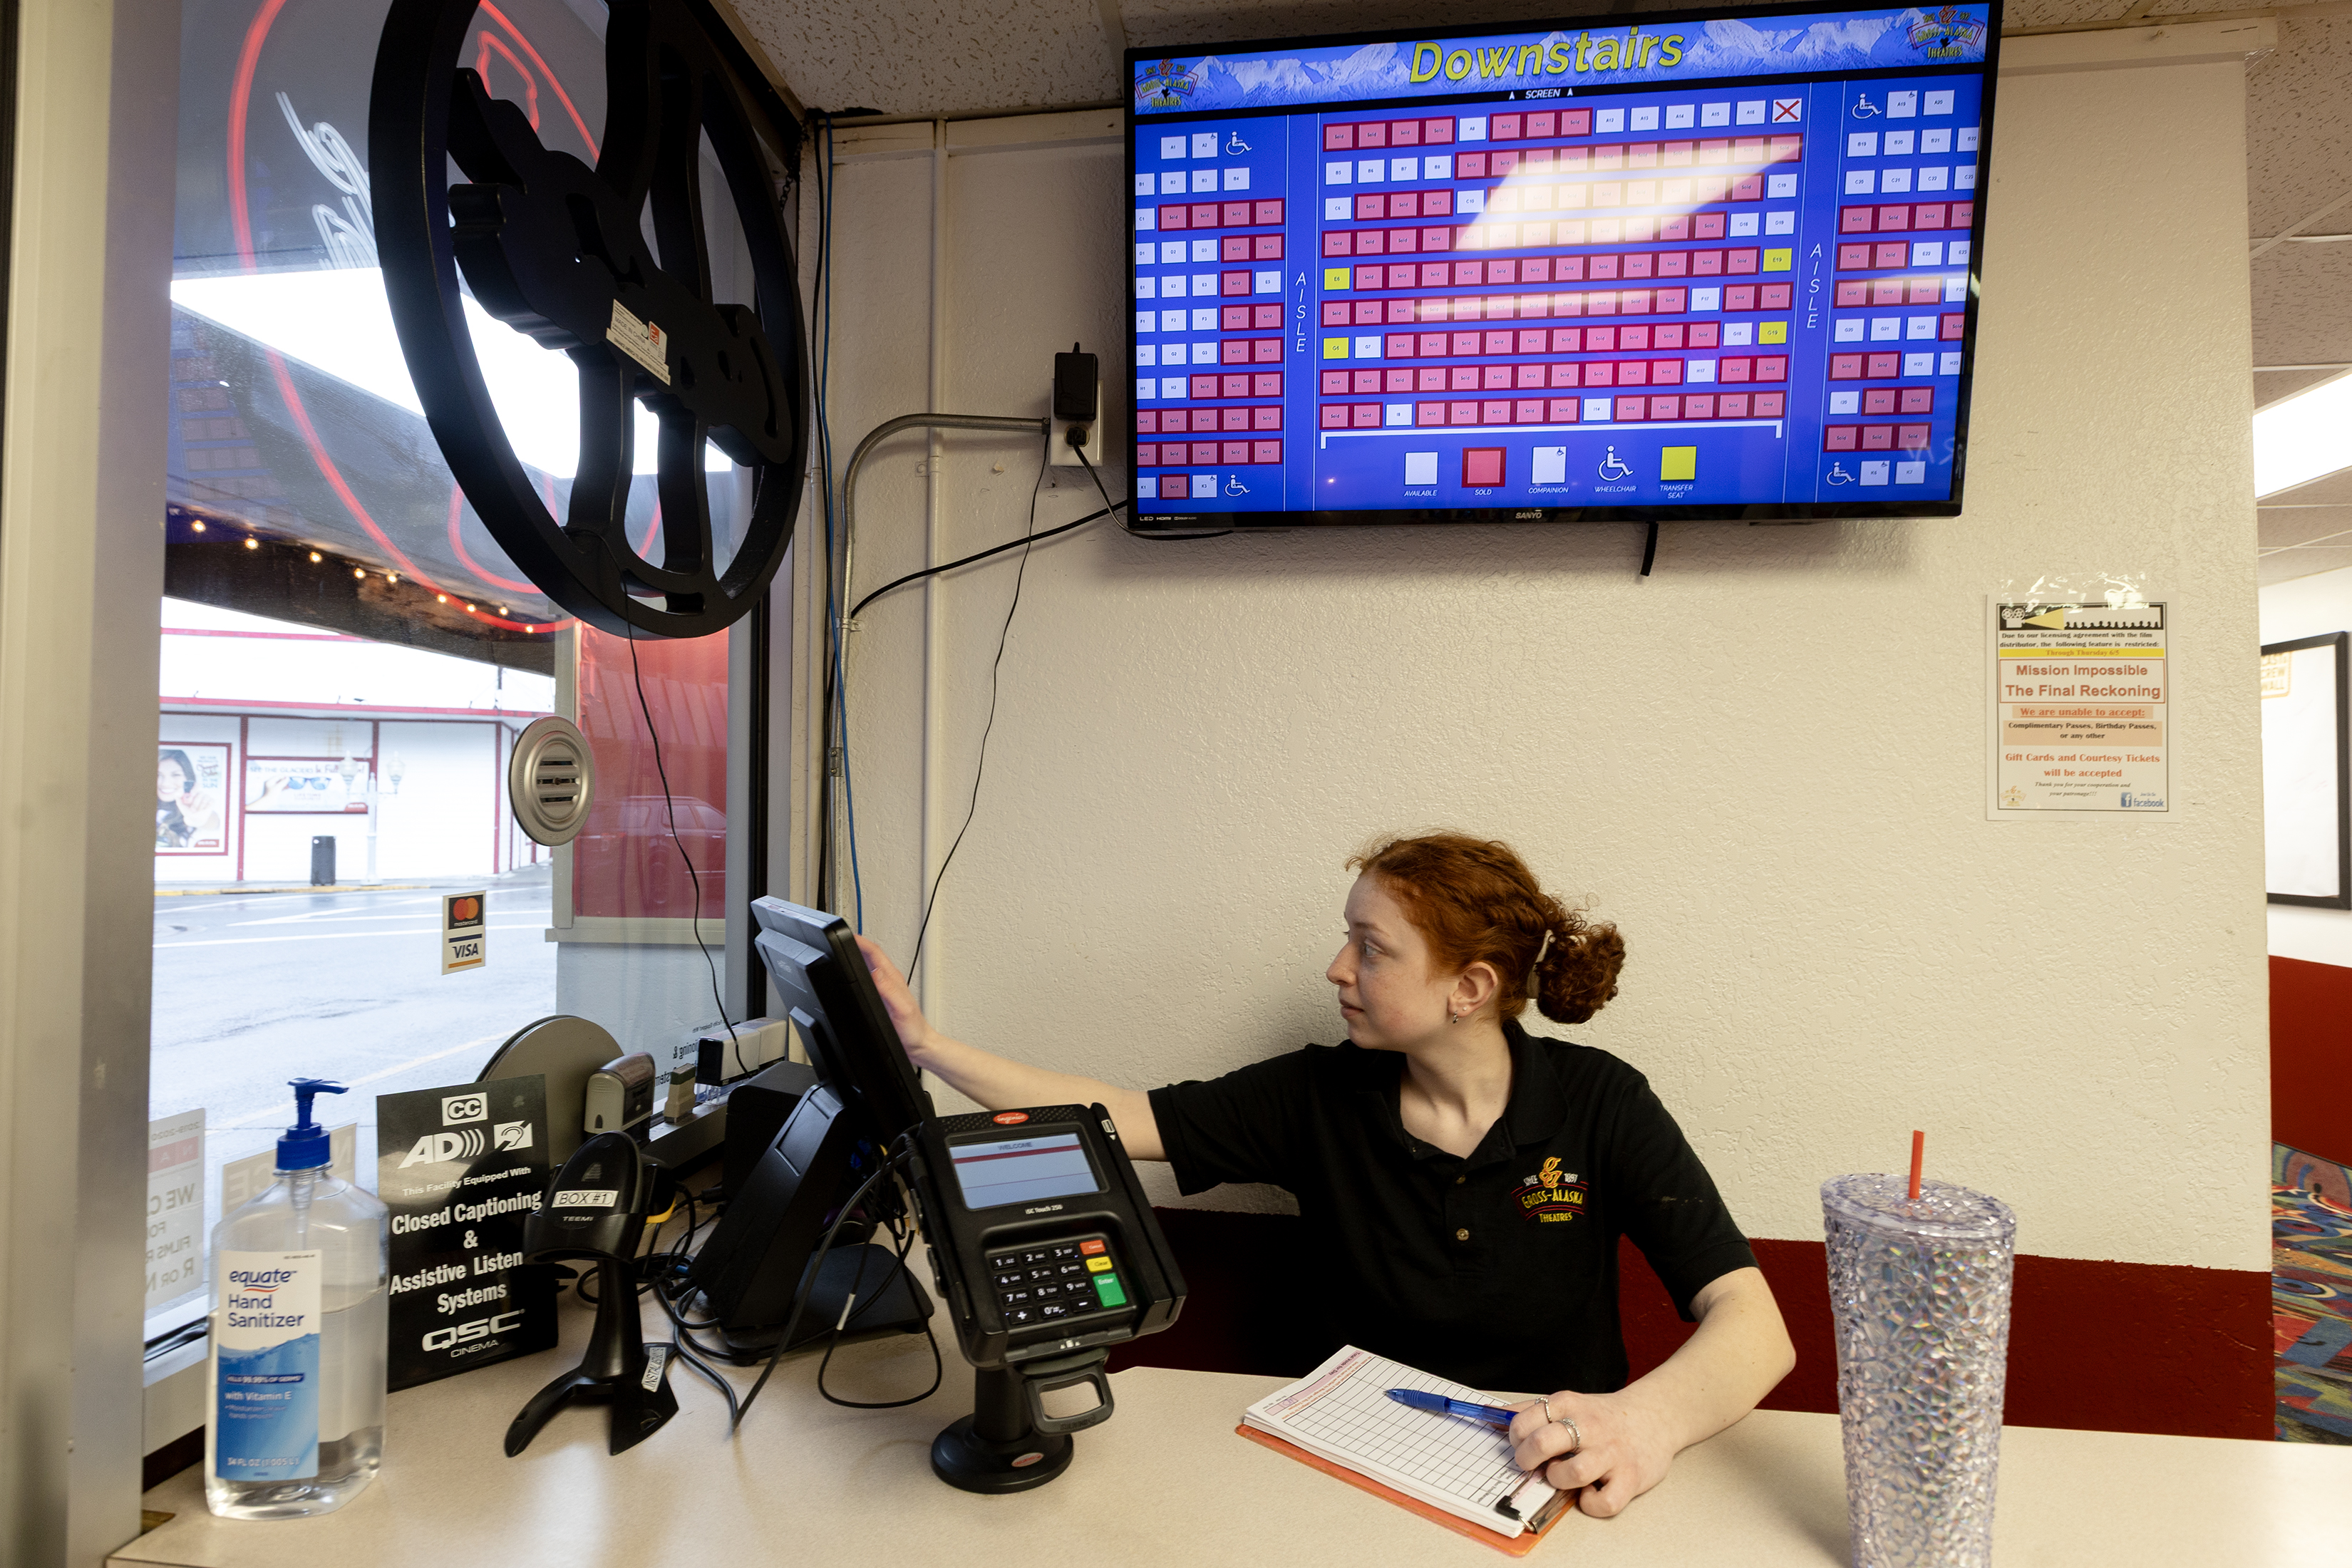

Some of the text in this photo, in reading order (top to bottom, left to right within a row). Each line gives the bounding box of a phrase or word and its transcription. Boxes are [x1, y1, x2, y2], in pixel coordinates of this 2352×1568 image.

[1409, 26, 1684, 83] Downstairs
[1525, 88, 1561, 99] SCREEN
[1806, 243, 1823, 329] AISLE
[1295, 272, 1306, 353] AISLE
[1515, 510, 1542, 519] SANYO
[2016, 665, 2147, 677] Mission Impossible
[2006, 685, 2160, 699] The Final Reckoning
[2079, 754, 2123, 763] Courtesy
[2078, 770, 2122, 778] accepted
[453, 943, 478, 959] VISA
[448, 1100, 481, 1118] CC
[998, 1142, 1032, 1150] WELCOME
[402, 1167, 531, 1196] This Facility Equipped With
[559, 1193, 607, 1205] BOX #1
[1522, 1188, 1584, 1209] GROSS-ALASKA
[392, 1190, 542, 1234] Closed Captioning
[1538, 1212, 1573, 1223] THEATRES
[463, 1230, 478, 1249] &
[229, 1269, 292, 1287] equate
[389, 1264, 467, 1295] Assistive
[228, 1294, 272, 1309] Hand
[437, 1284, 507, 1315] Systems
[228, 1312, 304, 1328] Sanitizer
[422, 1311, 521, 1351] QSC
[450, 1339, 500, 1358] CINEMA
[225, 1391, 292, 1401] with Vitamin E
